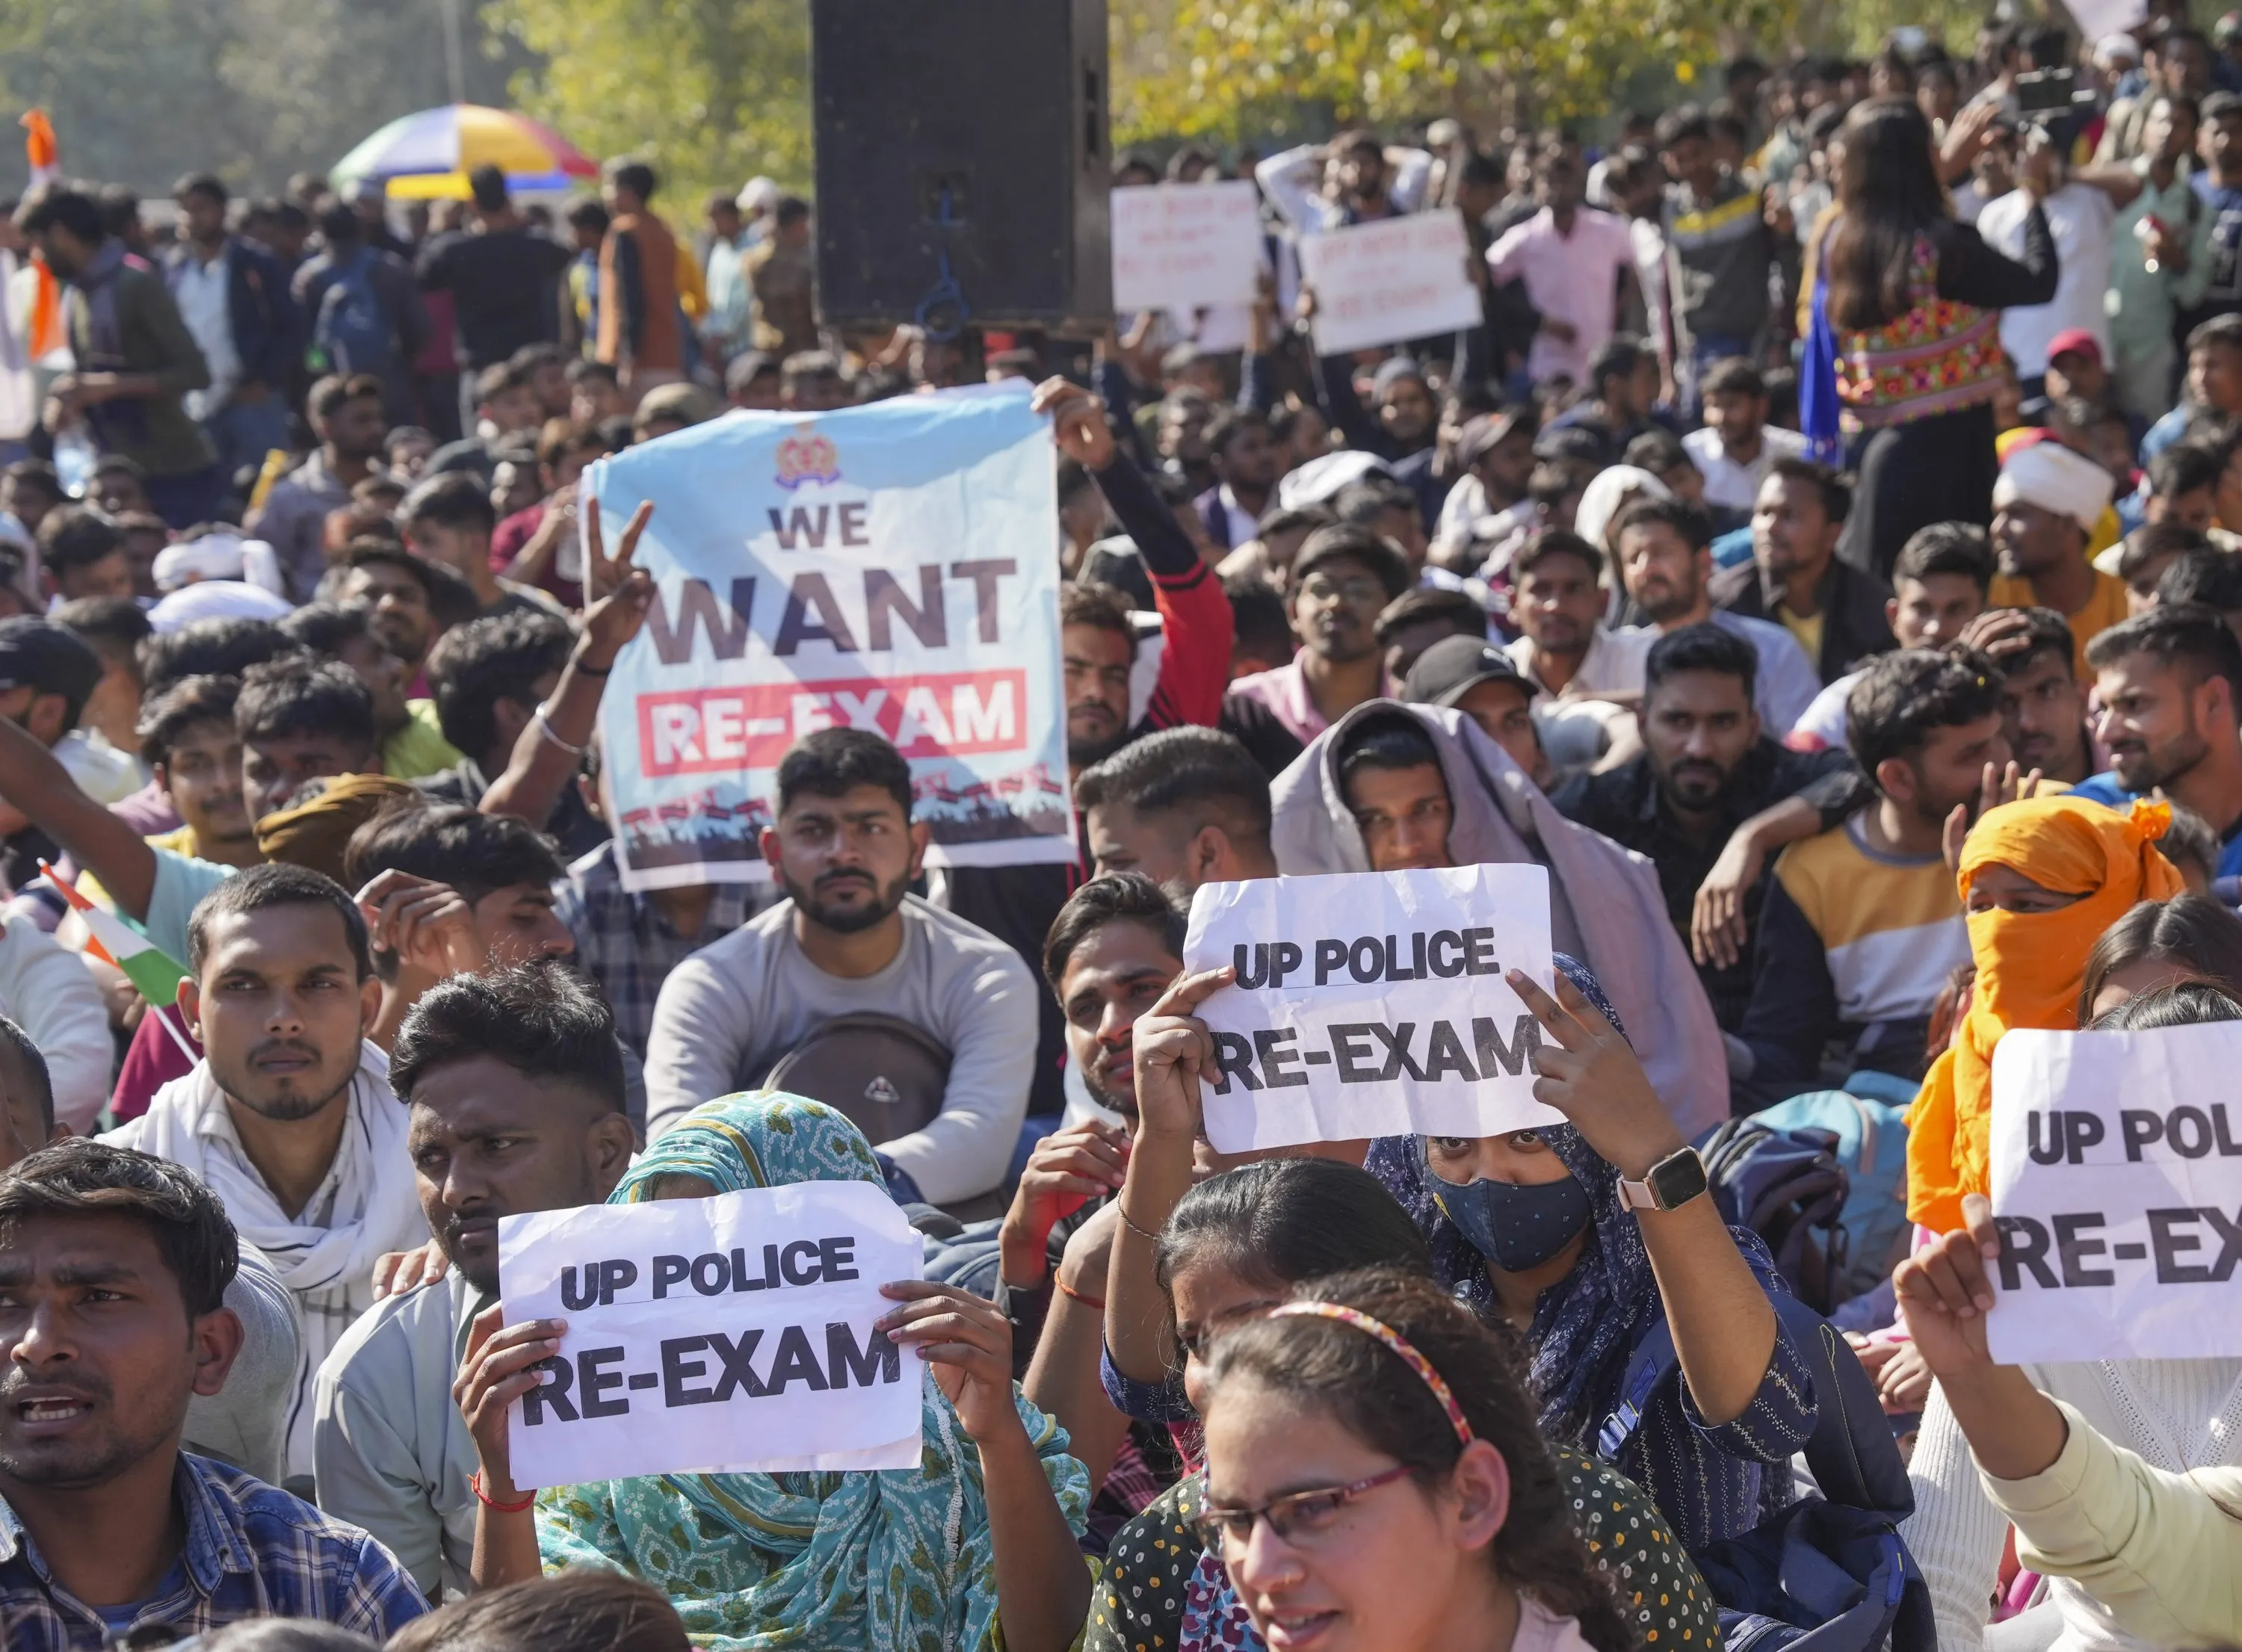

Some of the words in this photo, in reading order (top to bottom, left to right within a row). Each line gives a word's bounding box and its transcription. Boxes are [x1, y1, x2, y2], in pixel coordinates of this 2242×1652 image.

[768, 501, 870, 551] WE
[644, 559, 1017, 665] WANT
[649, 678, 1016, 764] RE-EXAM
[1234, 941, 1303, 990] UP
[1315, 926, 1500, 986] POLICE
[1209, 1013, 1542, 1095] RE-EXAM
[2028, 1110, 2104, 1166] UP
[2120, 1103, 2242, 1162] POL
[560, 1259, 637, 1311] UP
[652, 1237, 859, 1300] POLICE
[522, 1321, 901, 1426] RE-EXAM
